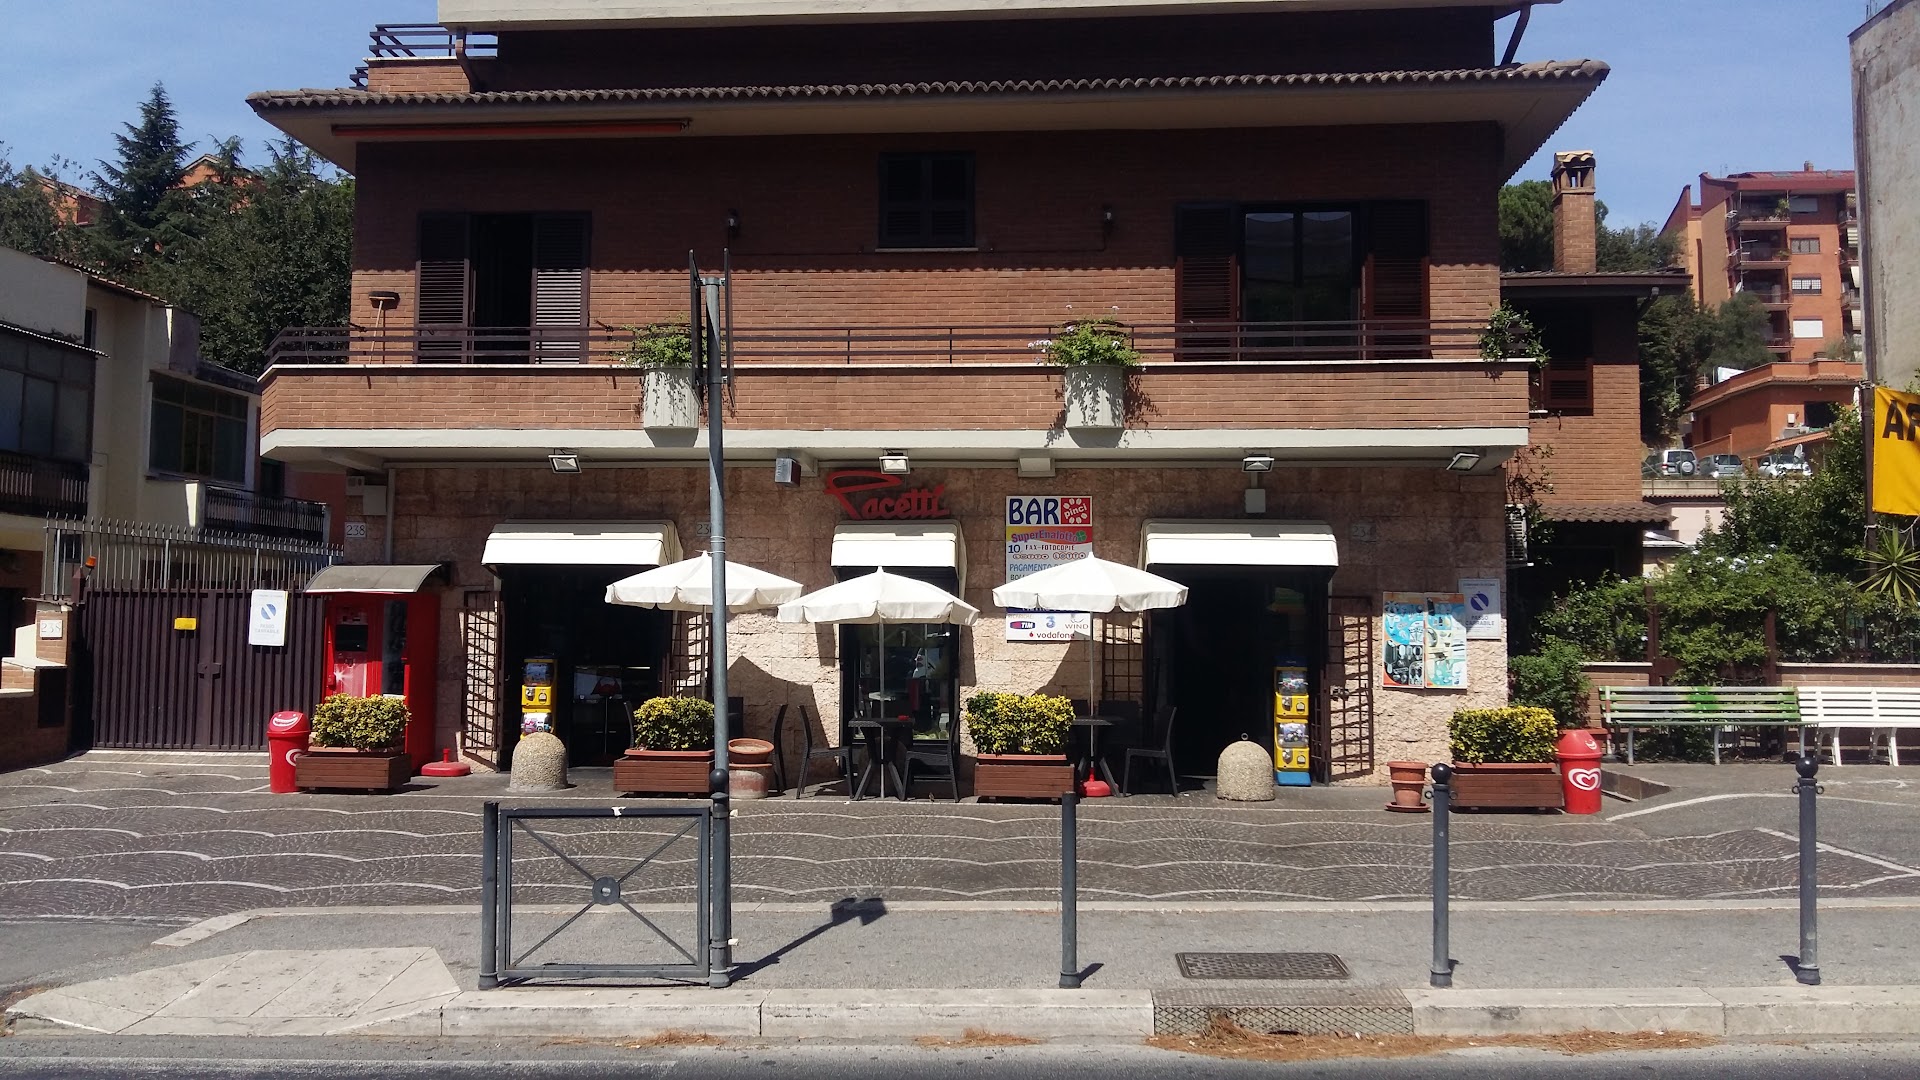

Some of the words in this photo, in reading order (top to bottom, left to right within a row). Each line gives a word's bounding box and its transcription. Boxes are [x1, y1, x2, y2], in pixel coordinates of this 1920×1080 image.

[824, 470, 950, 520] Pacetti
[1009, 498, 1060, 525] BAR
[1064, 503, 1088, 520] pinci
[346, 524, 366, 536] 238
[696, 523, 712, 535] 23
[1011, 529, 1079, 543] SuperEnalotto
[1008, 544, 1021, 554] 10
[1052, 551, 1086, 560] LOTTO
[1021, 621, 1034, 629] TIM
[1045, 615, 1056, 629] 3
[1036, 631, 1075, 639] vodafone
